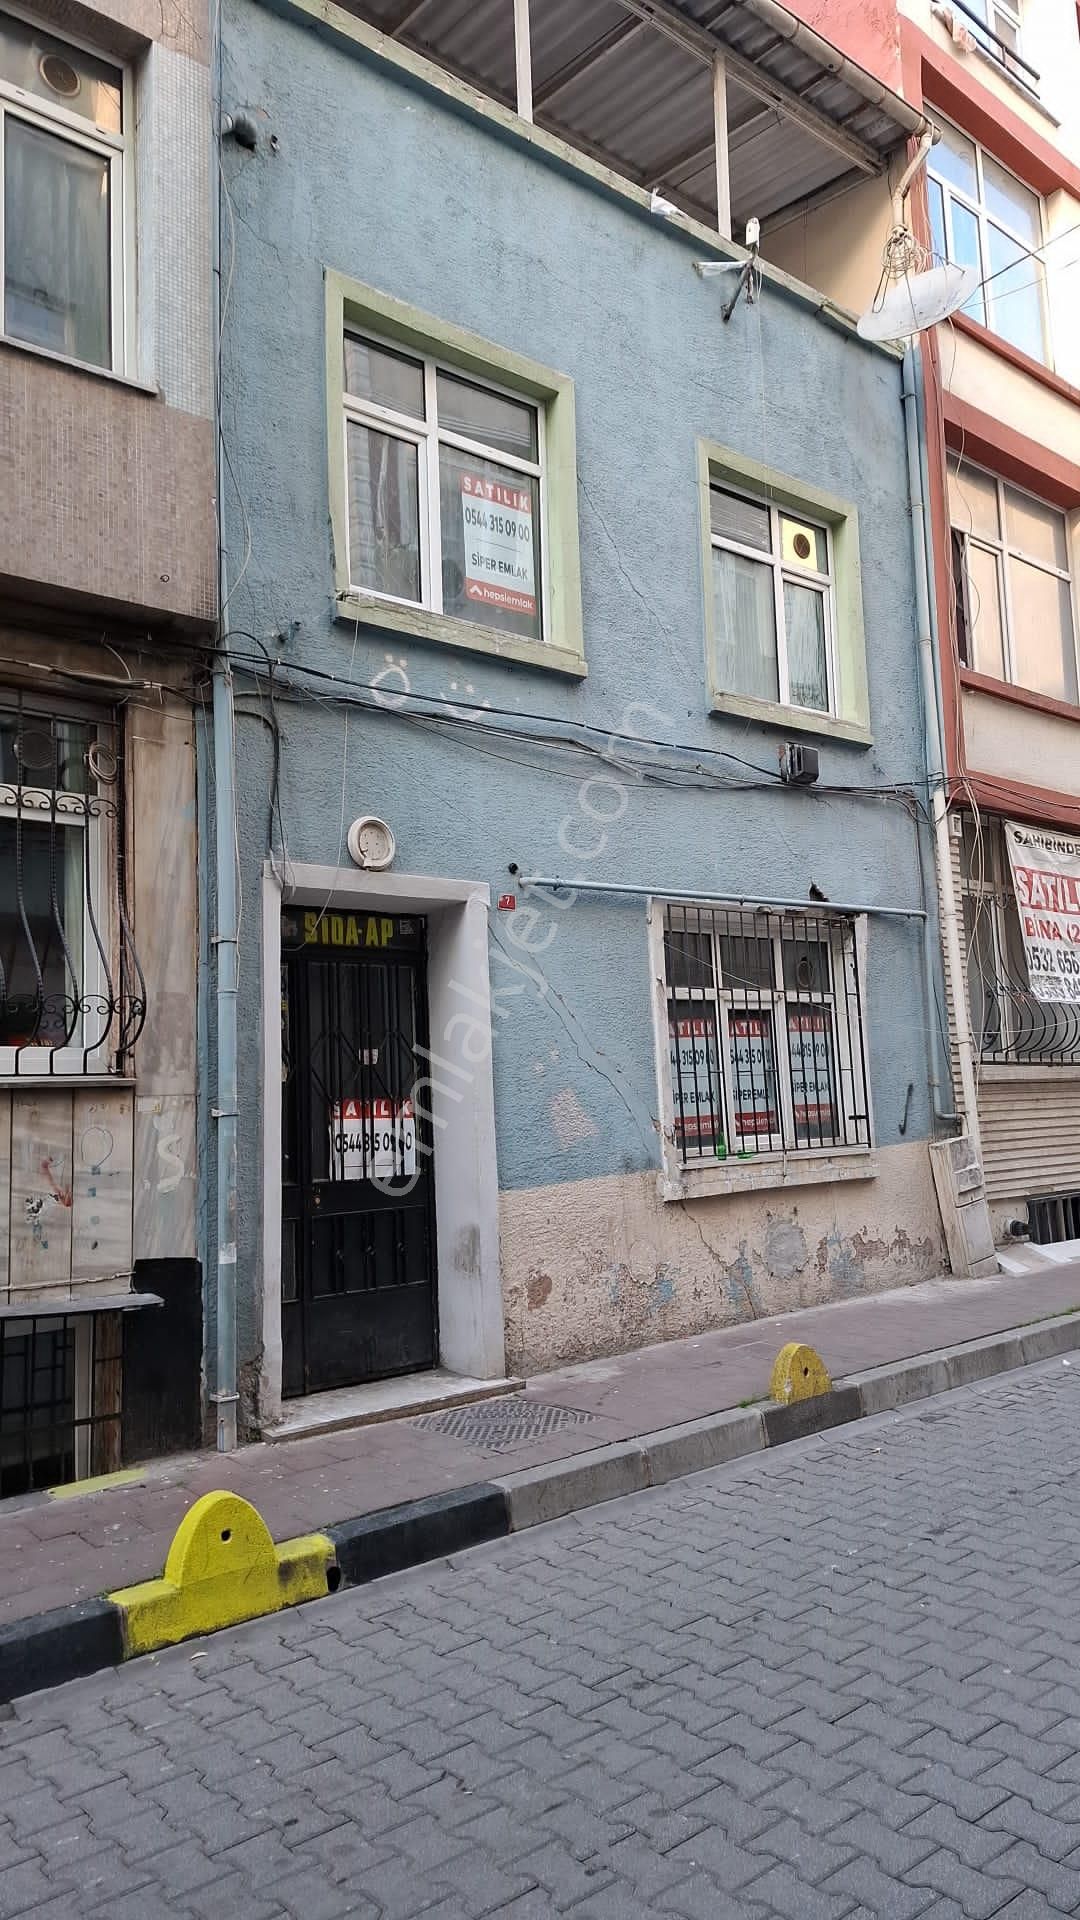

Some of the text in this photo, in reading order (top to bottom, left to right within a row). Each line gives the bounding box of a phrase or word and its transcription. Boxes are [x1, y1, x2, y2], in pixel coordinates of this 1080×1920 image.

[463, 475, 530, 511] SATILIK
[464, 506, 531, 542] 0544 315 09 00
[471, 551, 529, 580] SİPER EMLAK
[1024, 914, 1063, 941] BİNA
[1056, 948, 1080, 975] 656
